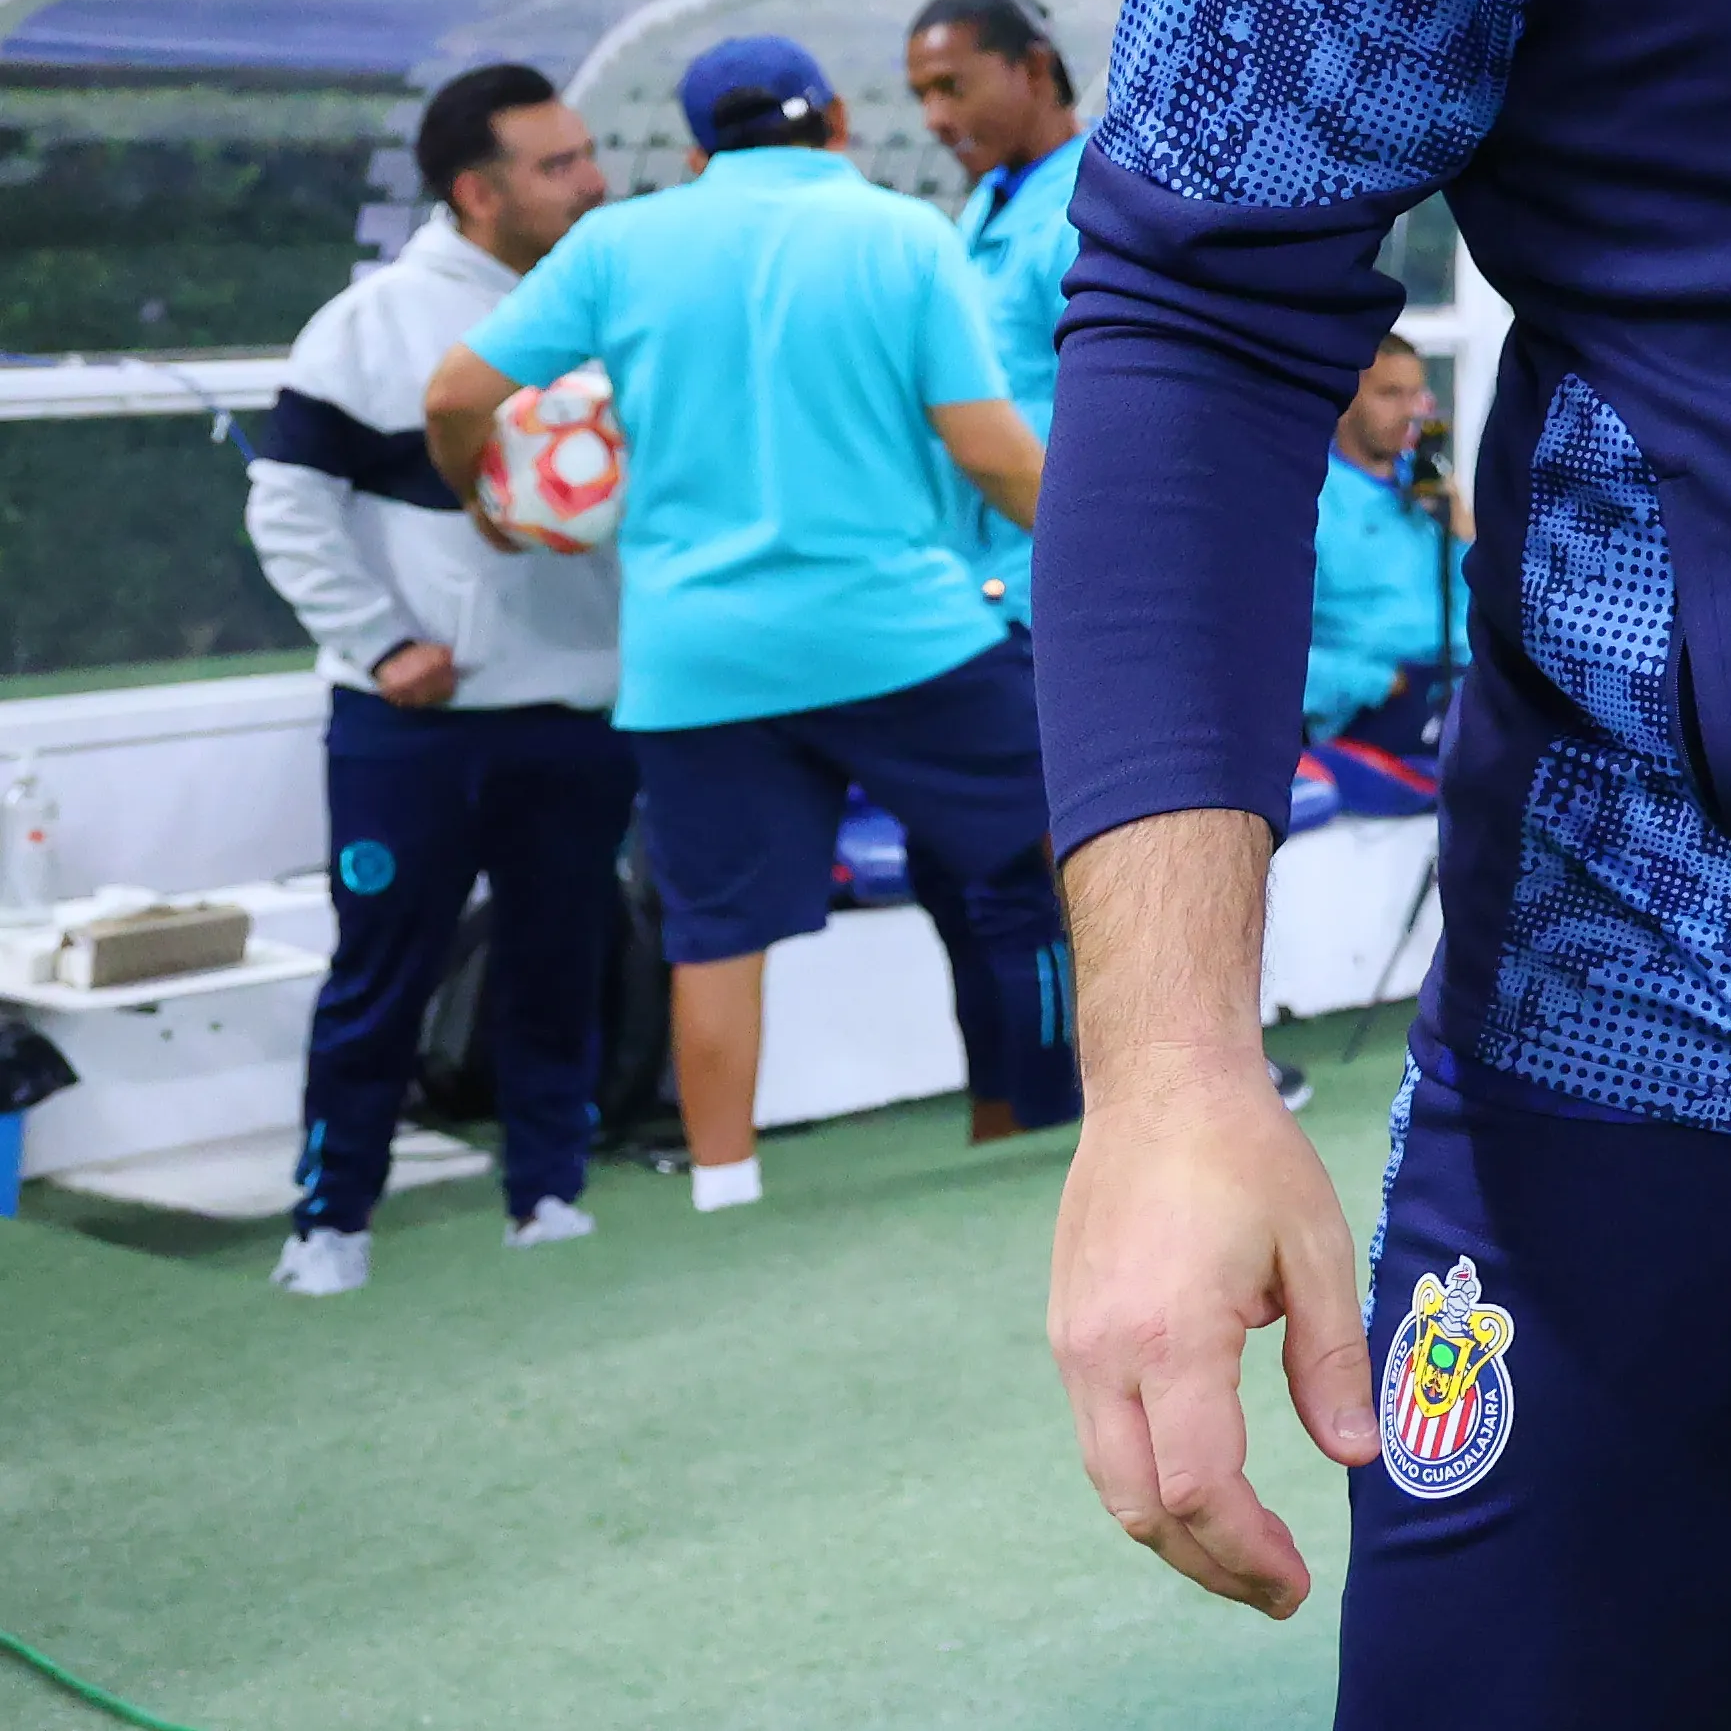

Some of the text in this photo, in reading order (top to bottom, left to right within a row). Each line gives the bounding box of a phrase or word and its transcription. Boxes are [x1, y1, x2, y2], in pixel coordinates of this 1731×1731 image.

[1385, 1340, 1498, 1482] CLUB DEPORTIVO GUADALAJARA
